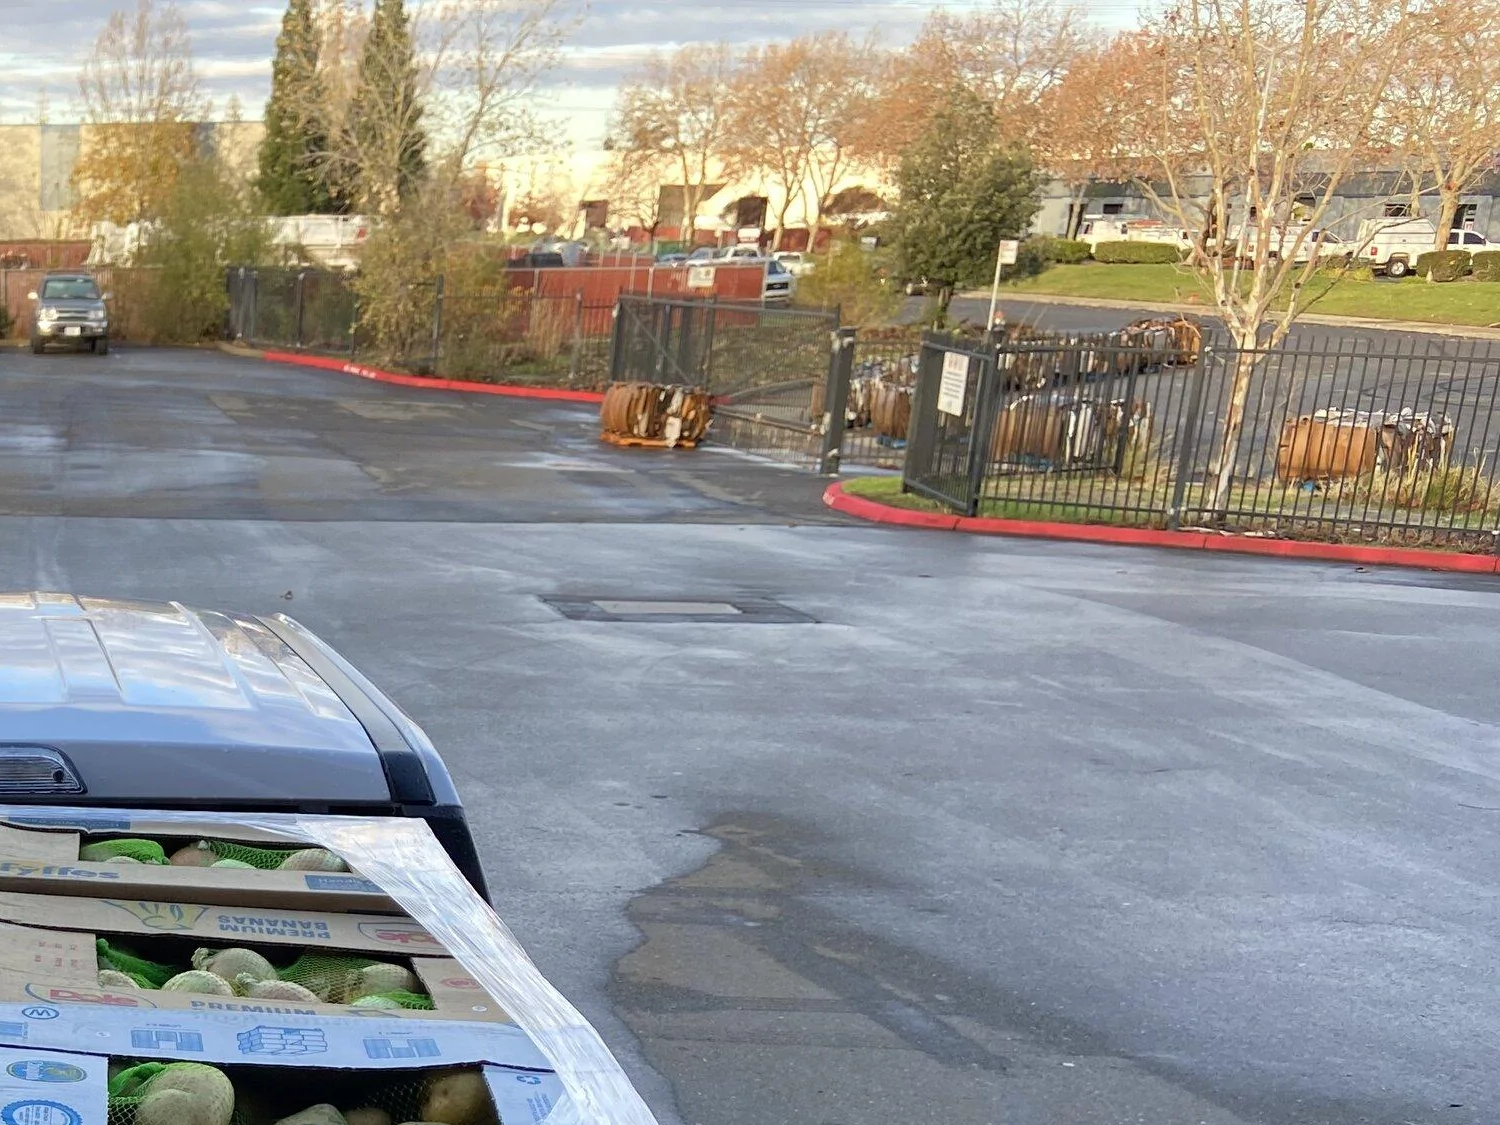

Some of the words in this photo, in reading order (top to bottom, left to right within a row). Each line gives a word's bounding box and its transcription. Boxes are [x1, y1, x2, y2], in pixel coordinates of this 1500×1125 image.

[217, 915, 329, 931] BANANAS
[217, 922, 331, 939] PREMIUM
[191, 1000, 317, 1015] PREMIUM
